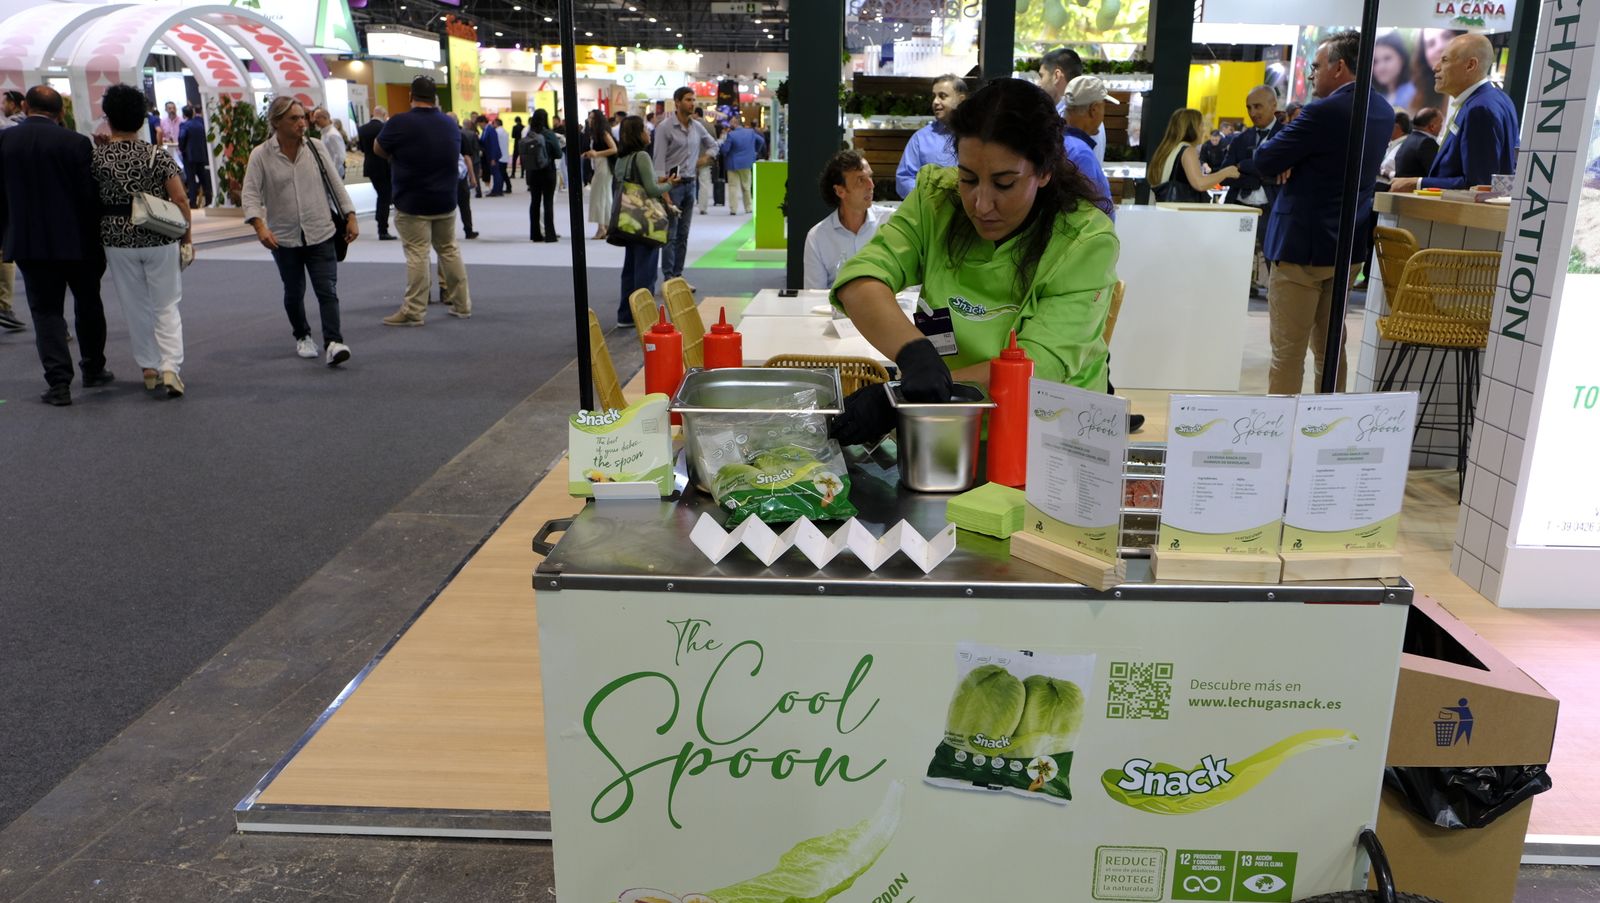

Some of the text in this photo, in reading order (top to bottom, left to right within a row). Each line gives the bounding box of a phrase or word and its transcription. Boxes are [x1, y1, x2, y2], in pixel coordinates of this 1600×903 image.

[1435, 1, 1506, 15] LA CAÑA
[952, 296, 987, 316] Snack
[576, 408, 621, 426] Snack
[1077, 411, 1118, 440] Spoon
[1231, 417, 1284, 446] Spoon
[1355, 414, 1407, 442] Spoon
[593, 450, 645, 473] the spoon
[755, 468, 795, 485] Snack
[666, 618, 723, 666] The
[696, 639, 880, 746] Cool
[1190, 679, 1302, 692] Descubre más en
[1188, 696, 1342, 711] www.lechugasnack.es
[583, 671, 887, 829] Spoon
[973, 733, 1011, 749] Snack
[1117, 754, 1235, 796] Snack
[1105, 855, 1157, 866] REDUCE
[1180, 853, 1191, 865] 12
[1241, 855, 1253, 867] 13
[1104, 874, 1155, 884] PROTEGE
